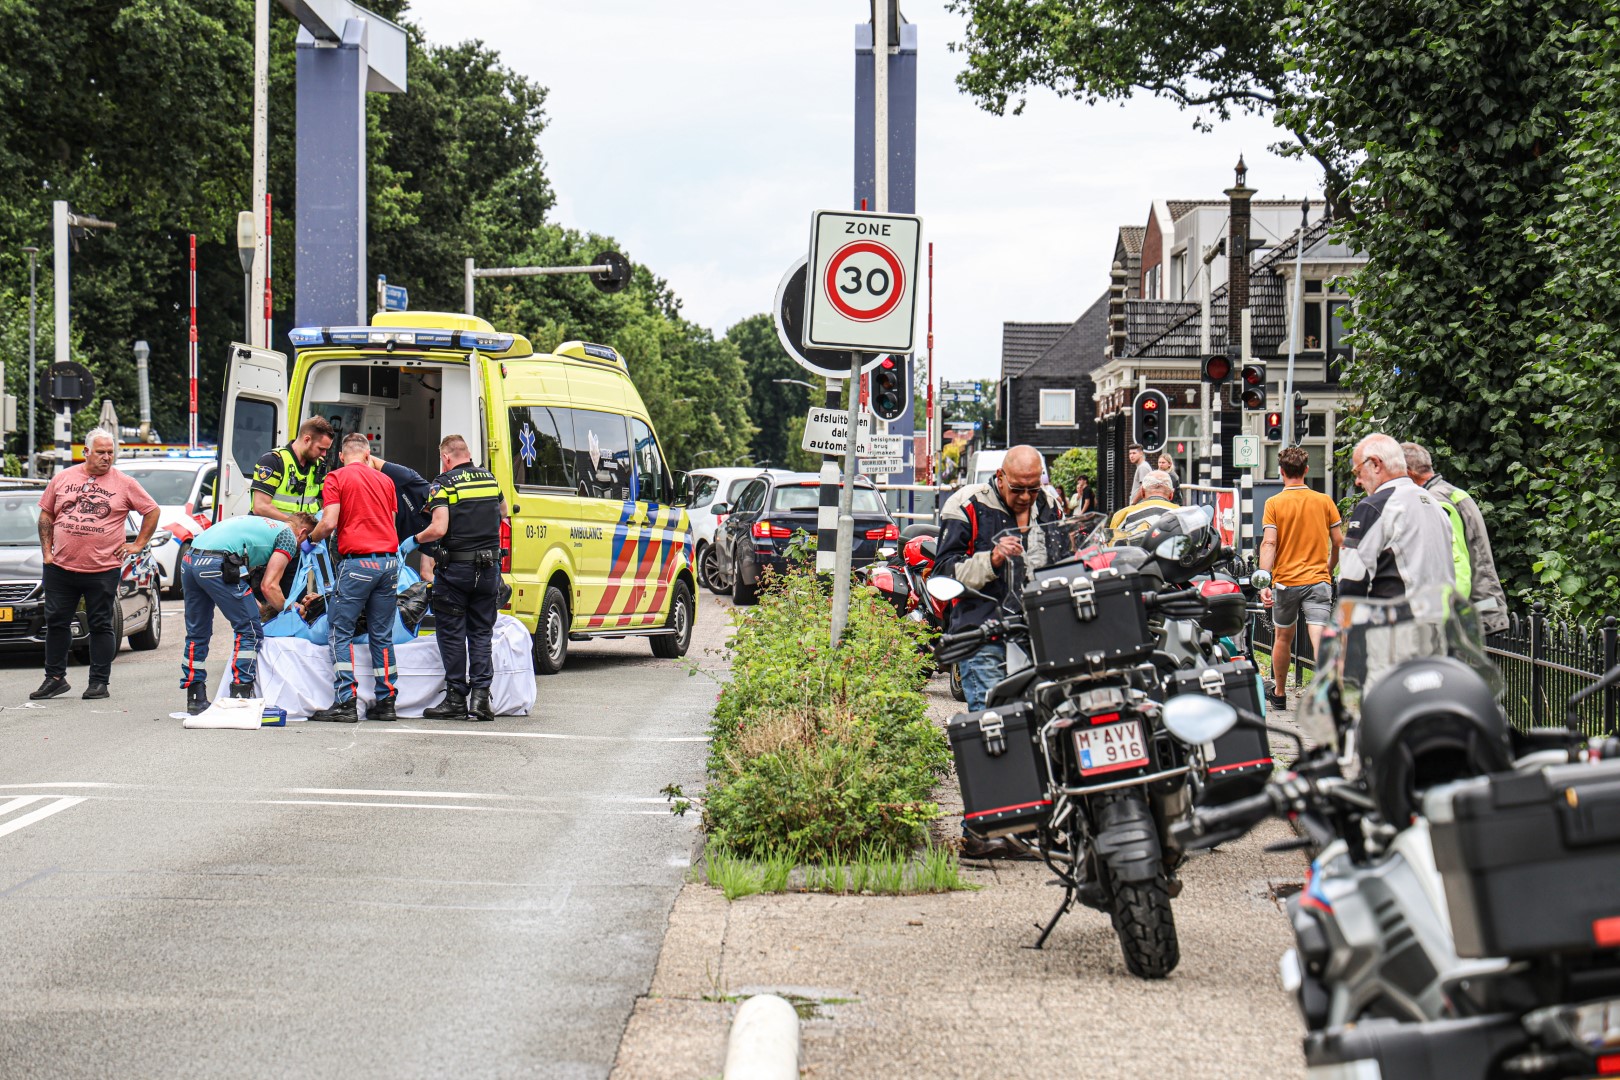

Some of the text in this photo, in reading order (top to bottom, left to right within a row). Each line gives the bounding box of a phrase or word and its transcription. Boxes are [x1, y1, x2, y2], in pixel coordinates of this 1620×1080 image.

[845, 221, 891, 236] ZONE
[840, 266, 890, 296] 30
[813, 413, 868, 427] afsluitben
[831, 428, 848, 438] dale
[810, 440, 865, 454] automach
[526, 525, 547, 539] 03-137
[570, 526, 602, 540] AMBULANCE
[1106, 742, 1141, 762] 916
